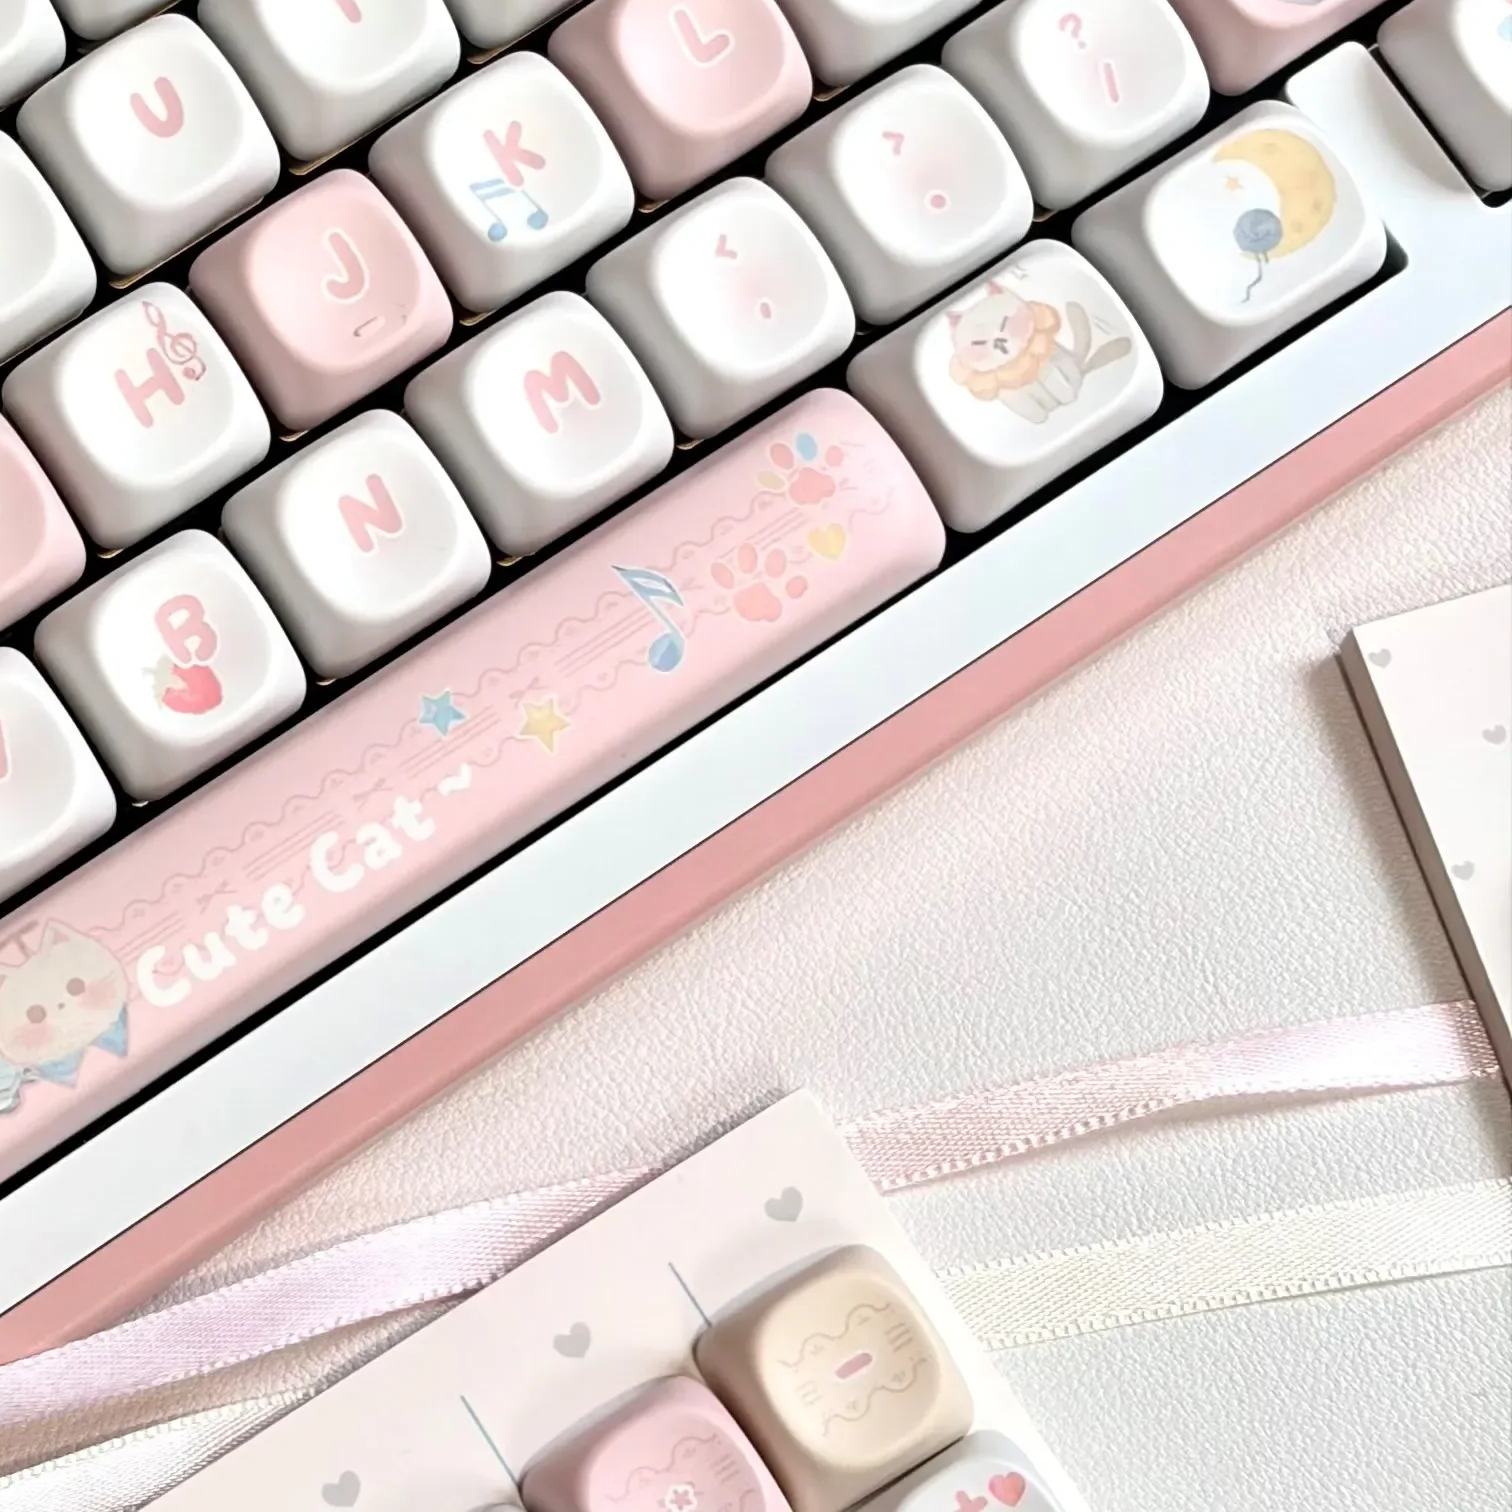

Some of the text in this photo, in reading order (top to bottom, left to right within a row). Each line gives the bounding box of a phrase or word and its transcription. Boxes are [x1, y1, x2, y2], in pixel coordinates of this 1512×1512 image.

[672, 8, 731, 64] L
[1059, 13, 1087, 49] ?
[129, 76, 184, 138] U
[483, 120, 546, 186] K
[326, 231, 366, 299] J
[116, 348, 185, 429] H
[523, 350, 600, 434] M
[339, 473, 403, 552] N
[156, 595, 219, 663] B
[137, 882, 305, 1007] Cute
